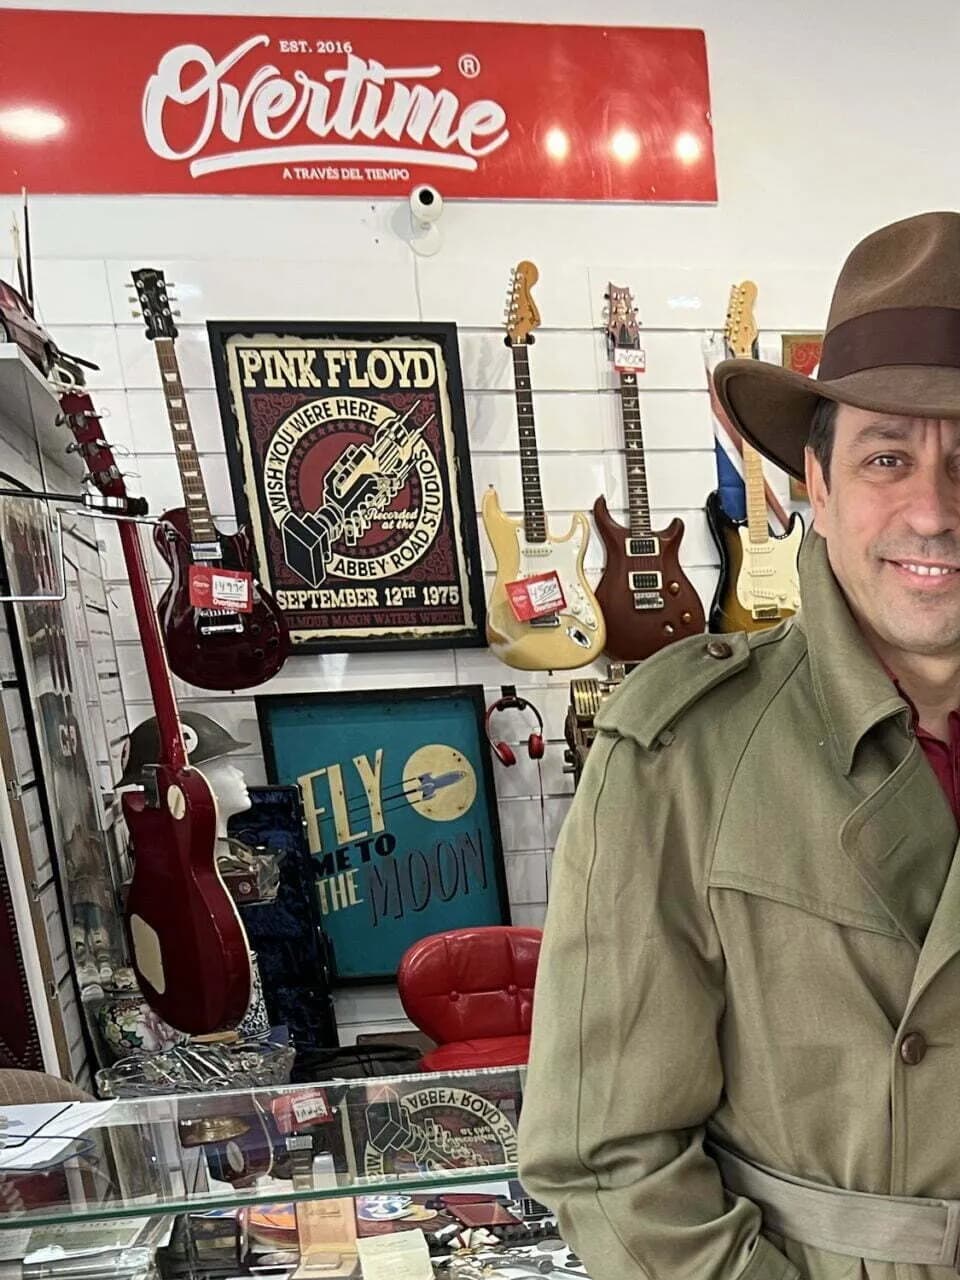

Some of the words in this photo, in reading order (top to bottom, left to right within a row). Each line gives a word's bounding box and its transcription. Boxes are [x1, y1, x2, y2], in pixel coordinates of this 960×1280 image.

[279, 40, 313, 53] EST.
[316, 40, 353, 54] 2016
[142, 35, 509, 161] Overtime
[282, 169, 293, 180] A
[293, 165, 341, 181] TRAVÉS
[341, 168, 364, 181] DEL
[364, 168, 410, 181] TIEMPO
[239, 350, 322, 389] PINK
[323, 350, 436, 389] FLOYD
[295, 403, 334, 433] WERE
[337, 400, 378, 420] HERE
[275, 428, 296, 464] YOU
[267, 463, 291, 514] WISH
[419, 449, 442, 527] STUDIOS
[365, 507, 418, 522] Recorded
[382, 520, 395, 530] at
[397, 519, 417, 530] the
[334, 559, 388, 577] ABBEY
[393, 528, 430, 568] ROAD
[276, 587, 379, 610] SEPTEMBER
[385, 586, 416, 607] 12TH
[422, 585, 460, 606] 1975
[286, 614, 328, 628] ILMOUR
[297, 748, 386, 855] FLY
[312, 849, 351, 877] ME
[355, 832, 397, 864] TO
[314, 868, 365, 916] THE
[367, 828, 488, 928] MOON
